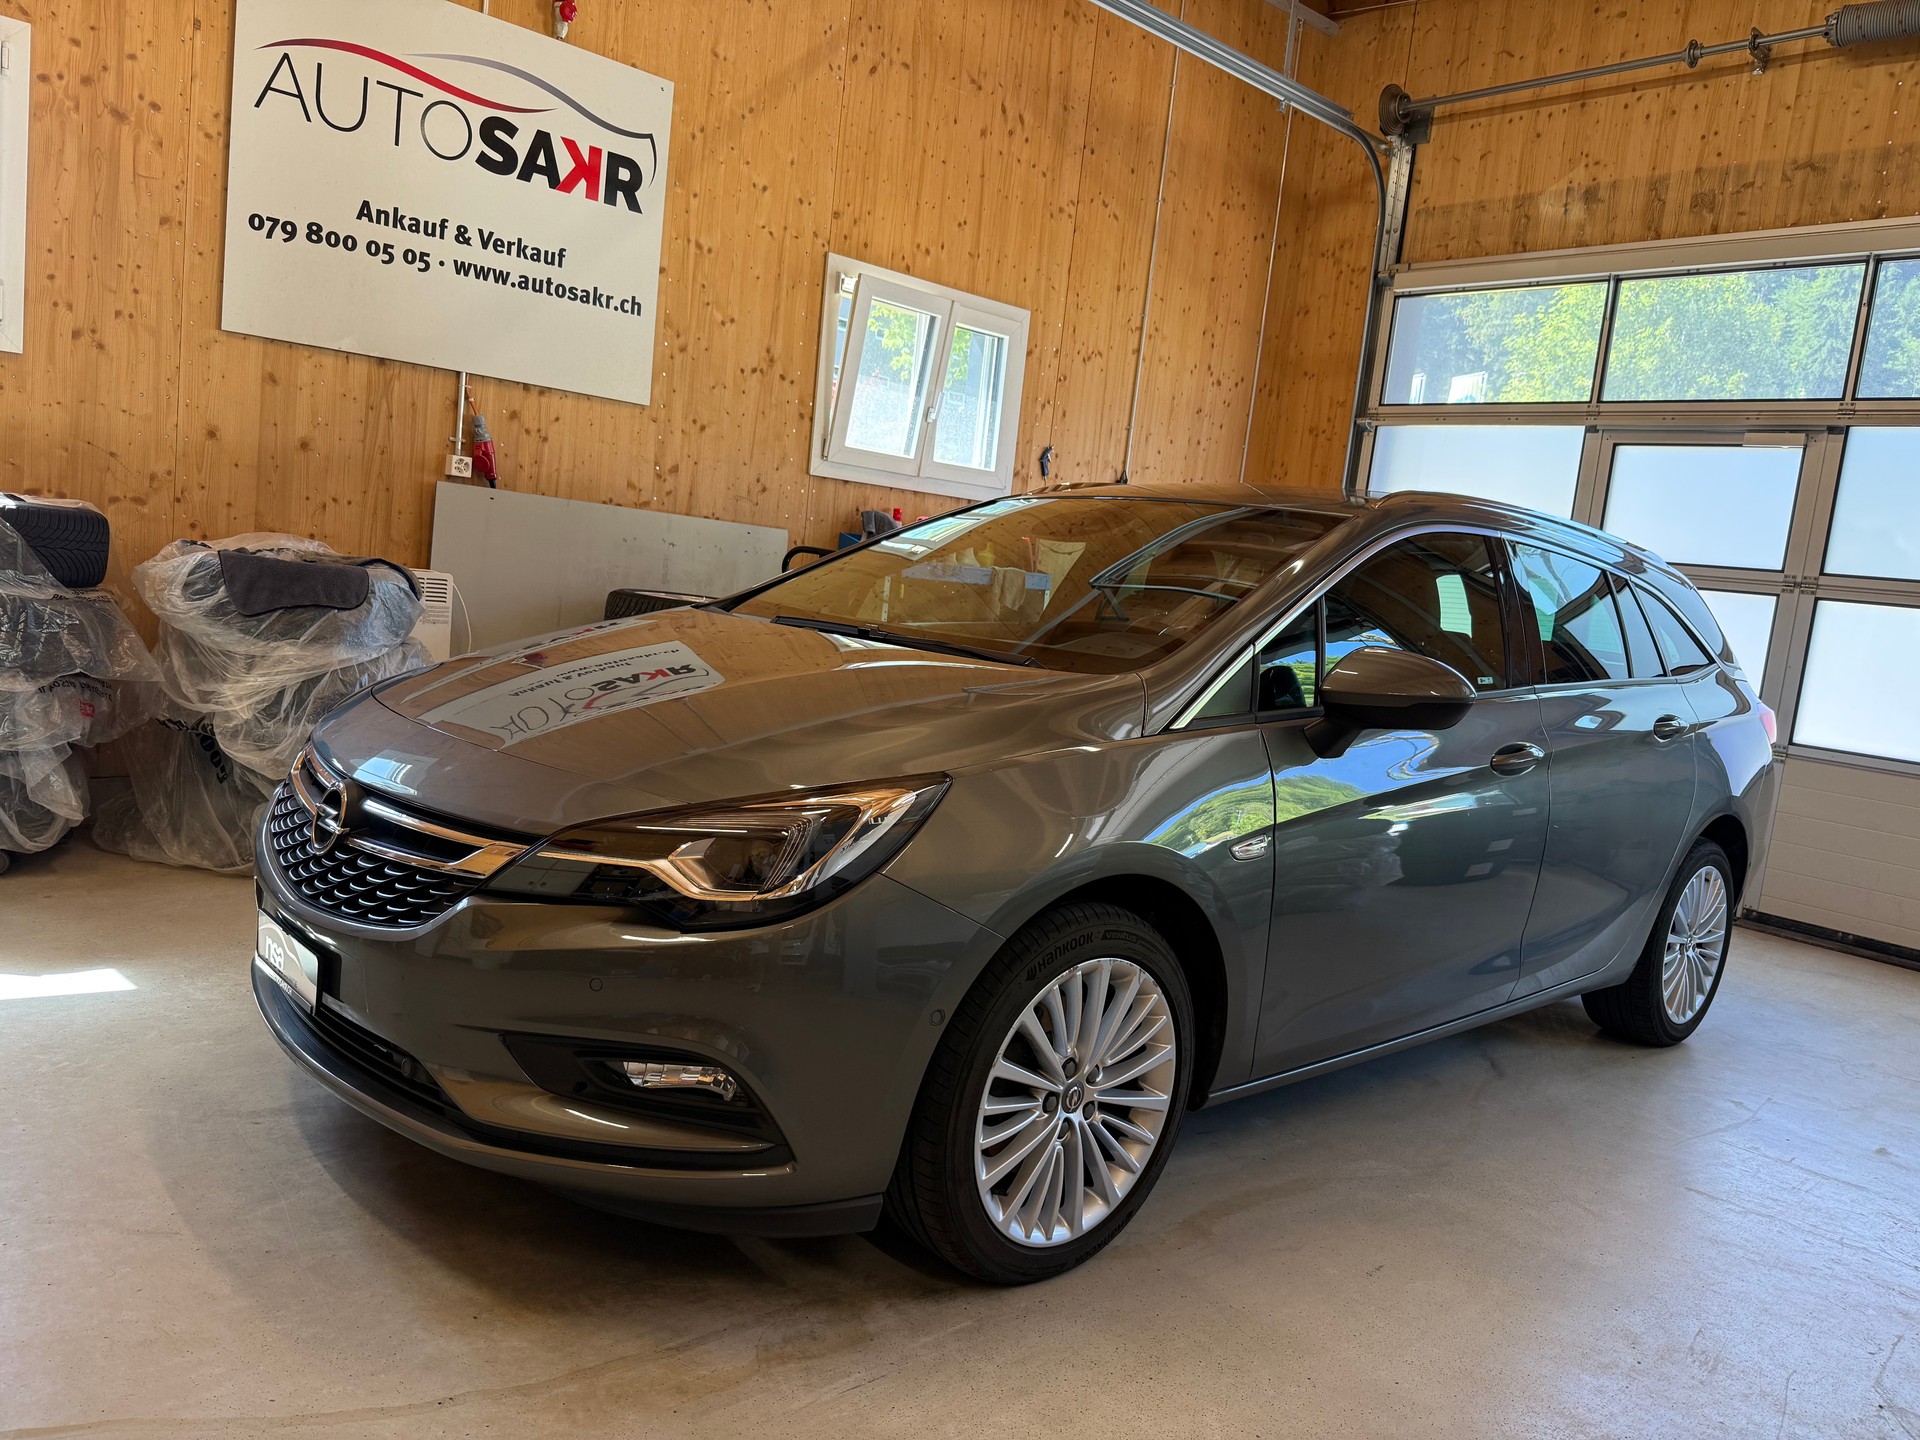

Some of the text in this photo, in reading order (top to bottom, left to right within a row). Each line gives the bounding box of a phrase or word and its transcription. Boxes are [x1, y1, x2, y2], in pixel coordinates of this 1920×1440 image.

[254, 53, 643, 215] AUTOSAKR
[248, 213, 298, 244] 079
[305, 221, 358, 252] 800
[366, 240, 395, 265] 05
[403, 248, 431, 273] 05
[453, 259, 642, 317] www.autosakr.ch
[356, 200, 566, 268] Ankauf & Verkauf
